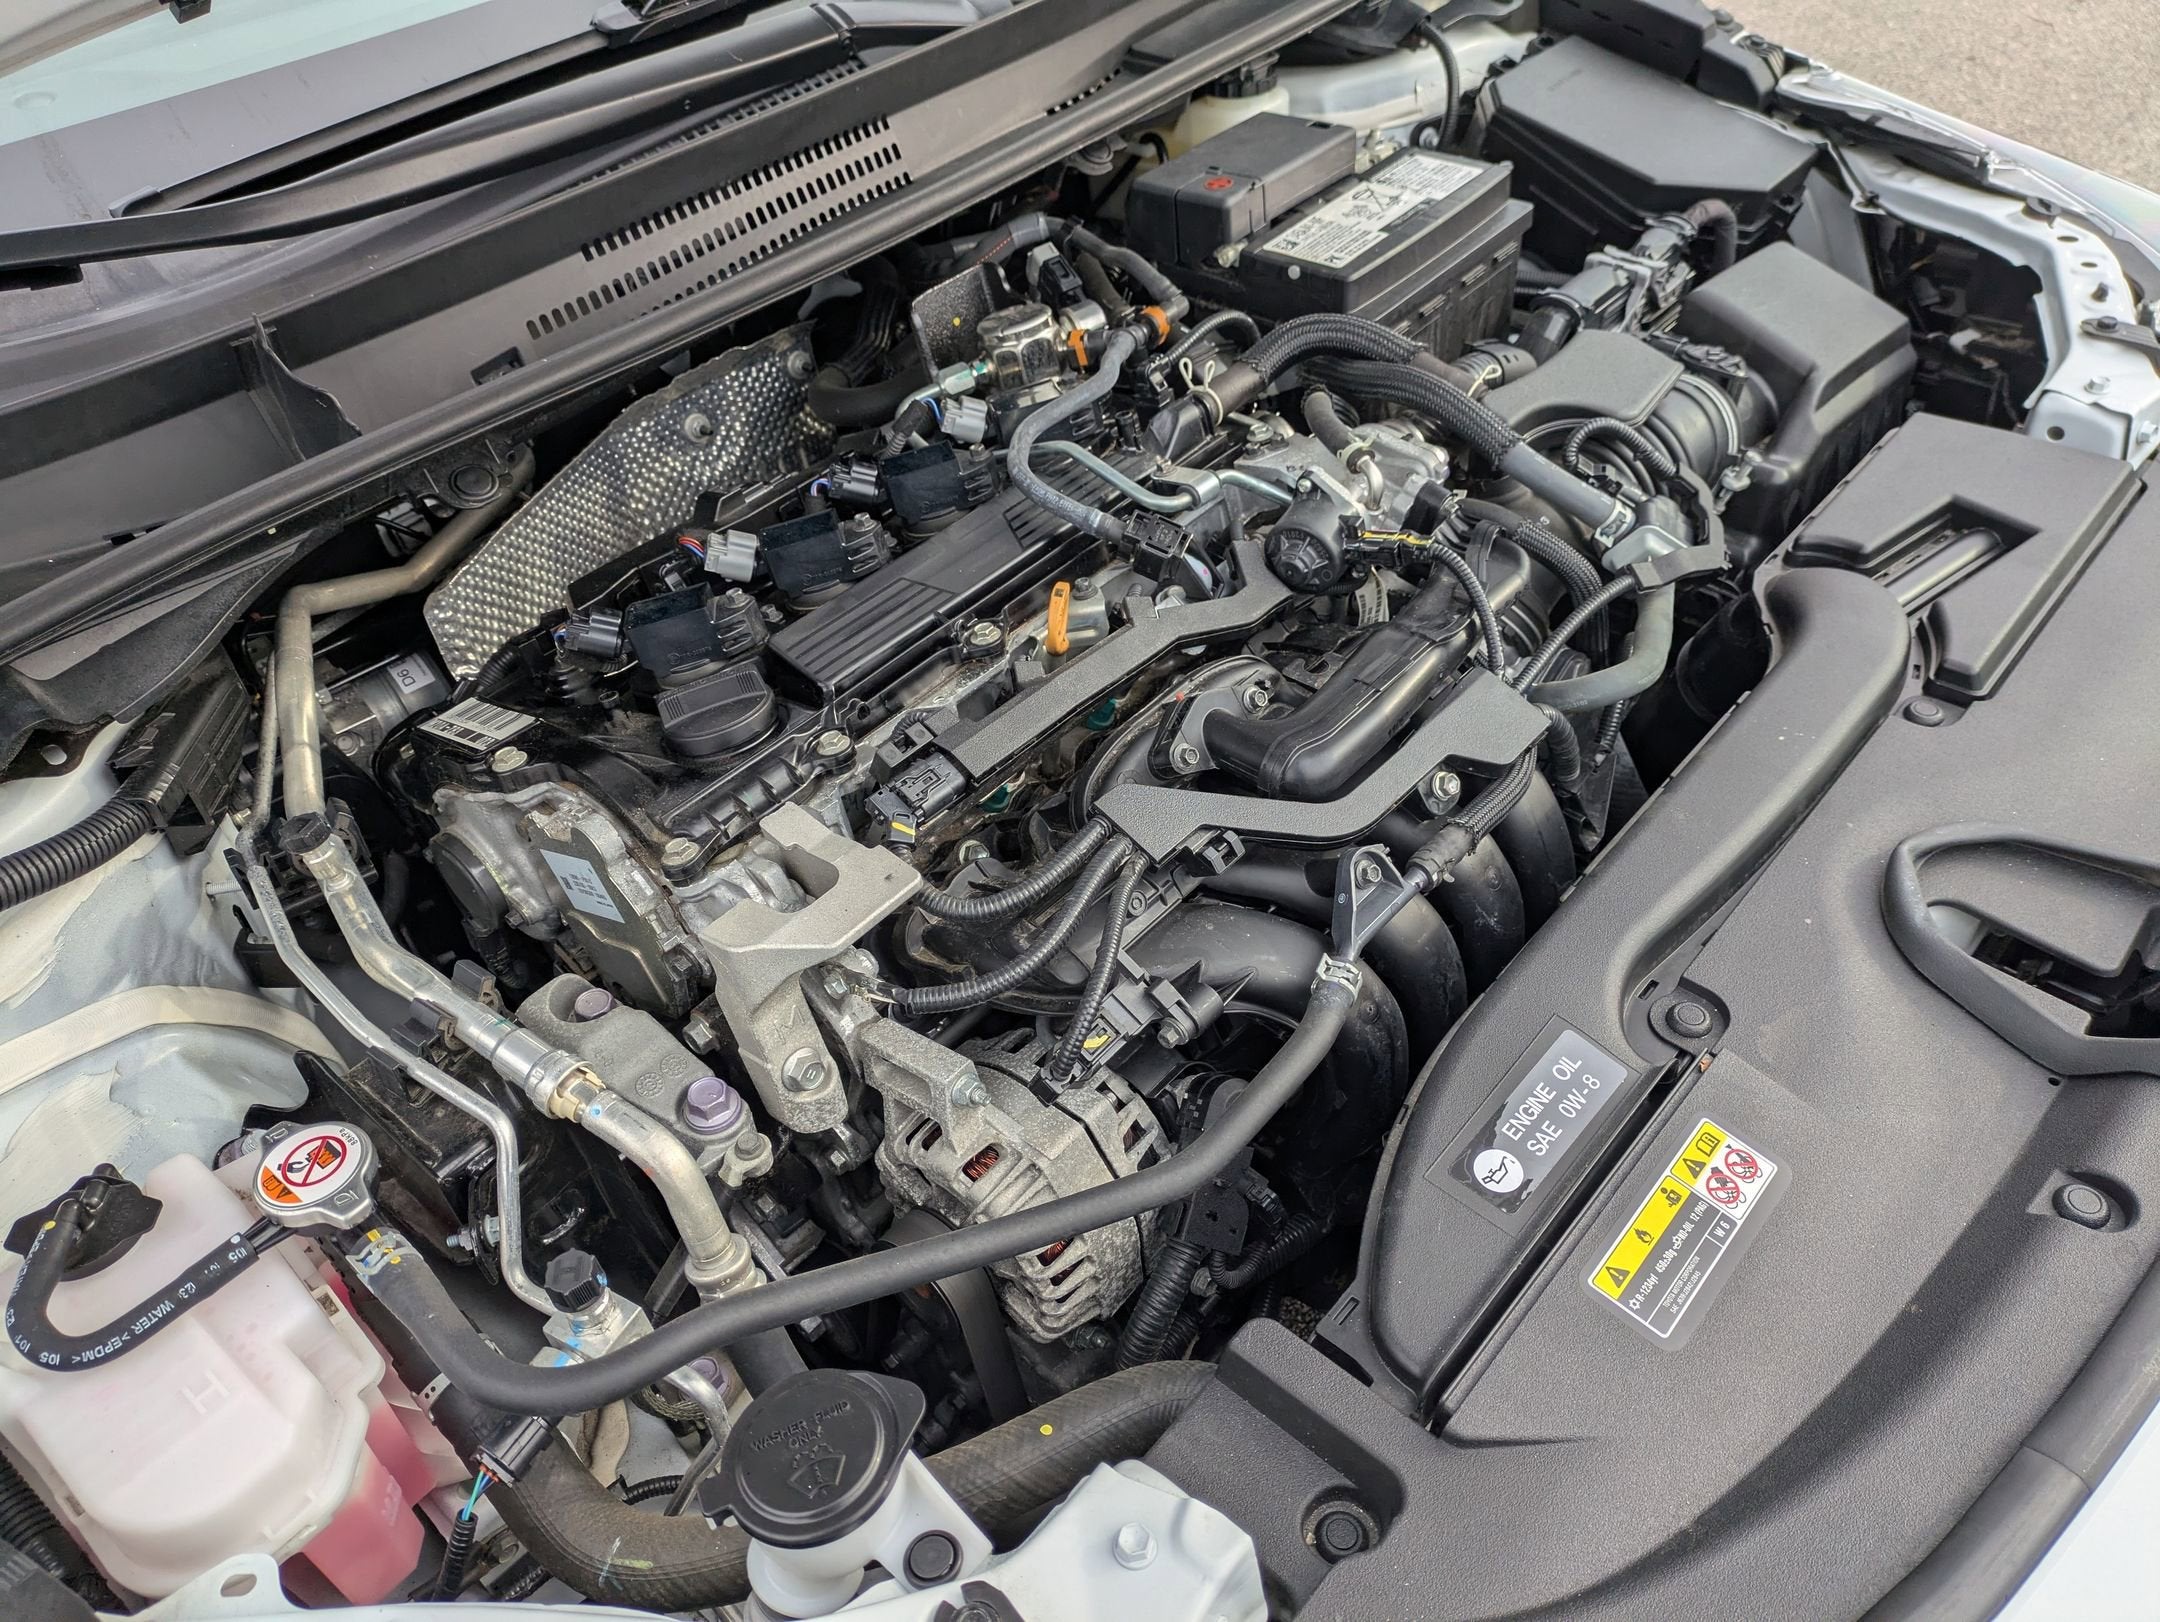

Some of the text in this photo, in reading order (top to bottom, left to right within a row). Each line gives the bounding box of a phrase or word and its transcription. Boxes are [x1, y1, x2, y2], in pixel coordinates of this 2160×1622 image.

[1502, 1056, 1582, 1141] ENGINE OIL
[1527, 1074, 1600, 1156] SAE 0W-8
[339, 1128, 358, 1146] 88kPa
[1713, 1220, 1730, 1238] W 6
[1635, 1273, 1659, 1303] R-1234yf
[1662, 1255, 1700, 1308] TOYOTA MOTOR CORPORATION
[130, 1299, 175, 1335] WATER
[751, 1400, 851, 1452] WASHER FLUID
[788, 1425, 824, 1450] ONLY
